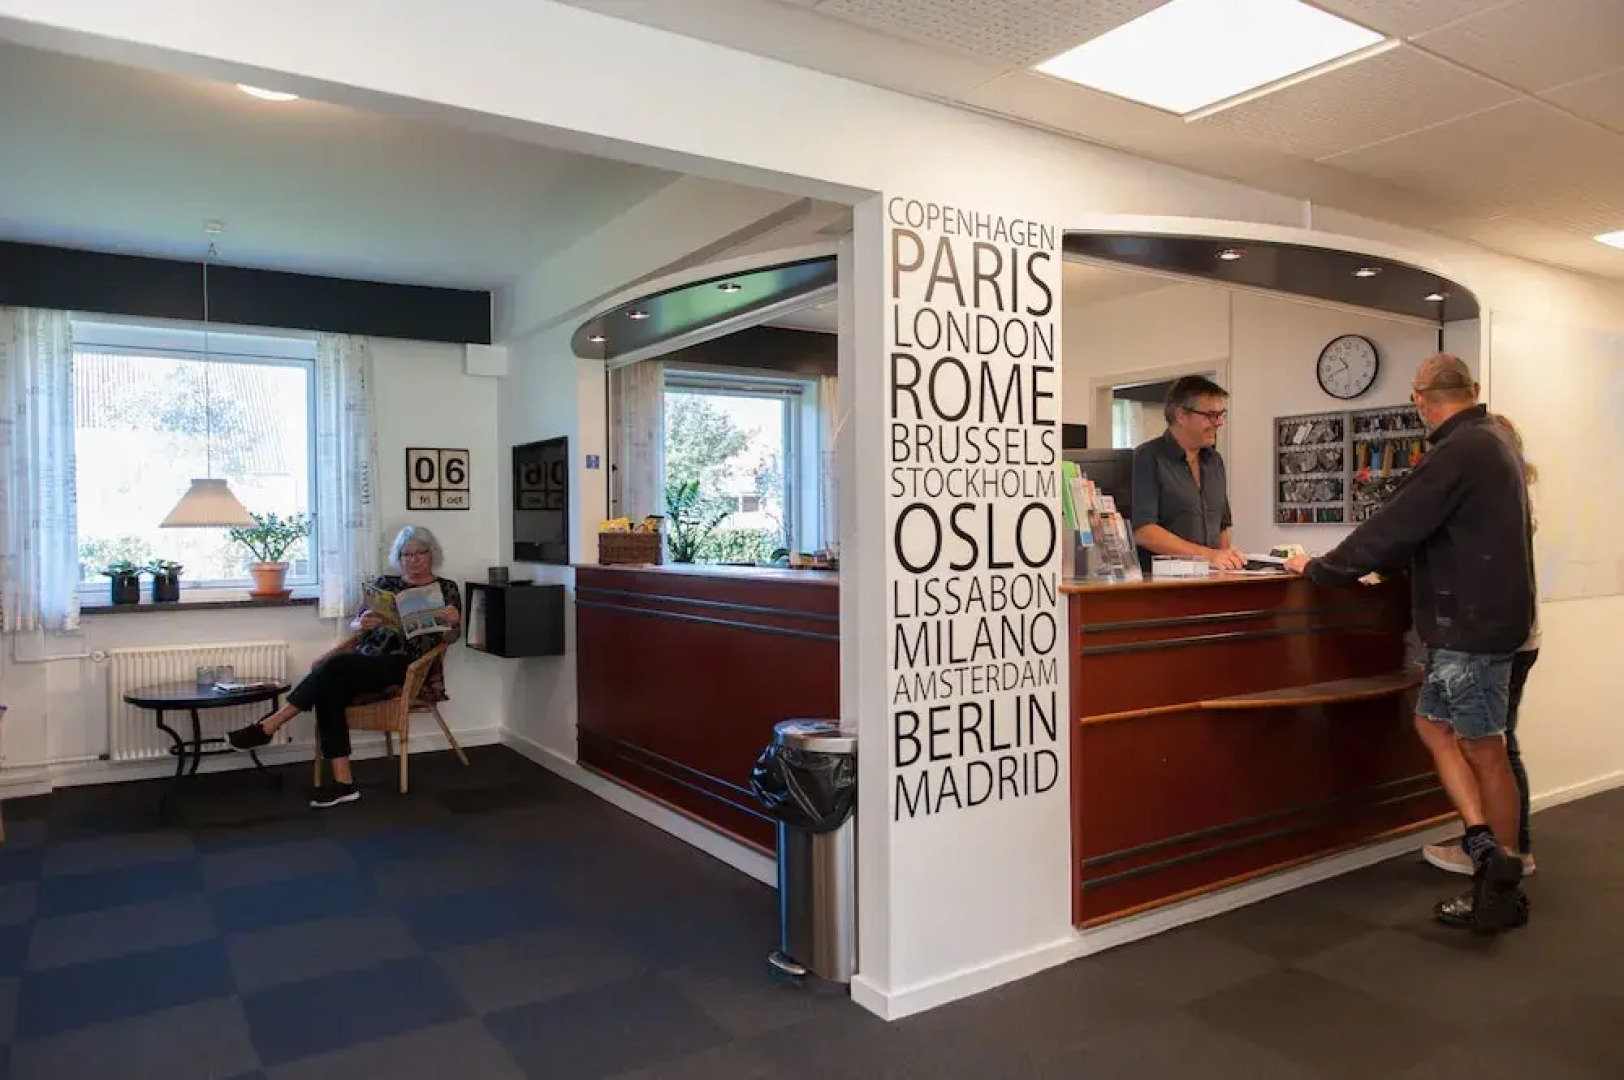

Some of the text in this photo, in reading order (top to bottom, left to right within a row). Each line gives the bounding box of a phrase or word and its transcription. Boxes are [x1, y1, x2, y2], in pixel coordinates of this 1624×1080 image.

[888, 196, 1055, 250] COPENHAGEN
[891, 228, 1053, 318] PARIS
[894, 303, 1055, 361] LONDON
[890, 352, 1056, 428] ROME
[891, 421, 1056, 466] BRUSSELS
[890, 467, 1057, 498] STOCKHOLM
[893, 501, 1057, 575] OSLO
[893, 572, 1057, 619] LISSABON
[893, 611, 1057, 671] MILANO
[893, 657, 1058, 705] AMSTERDAM
[894, 690, 1057, 769] BERLIN
[894, 748, 1060, 823] MADRID
